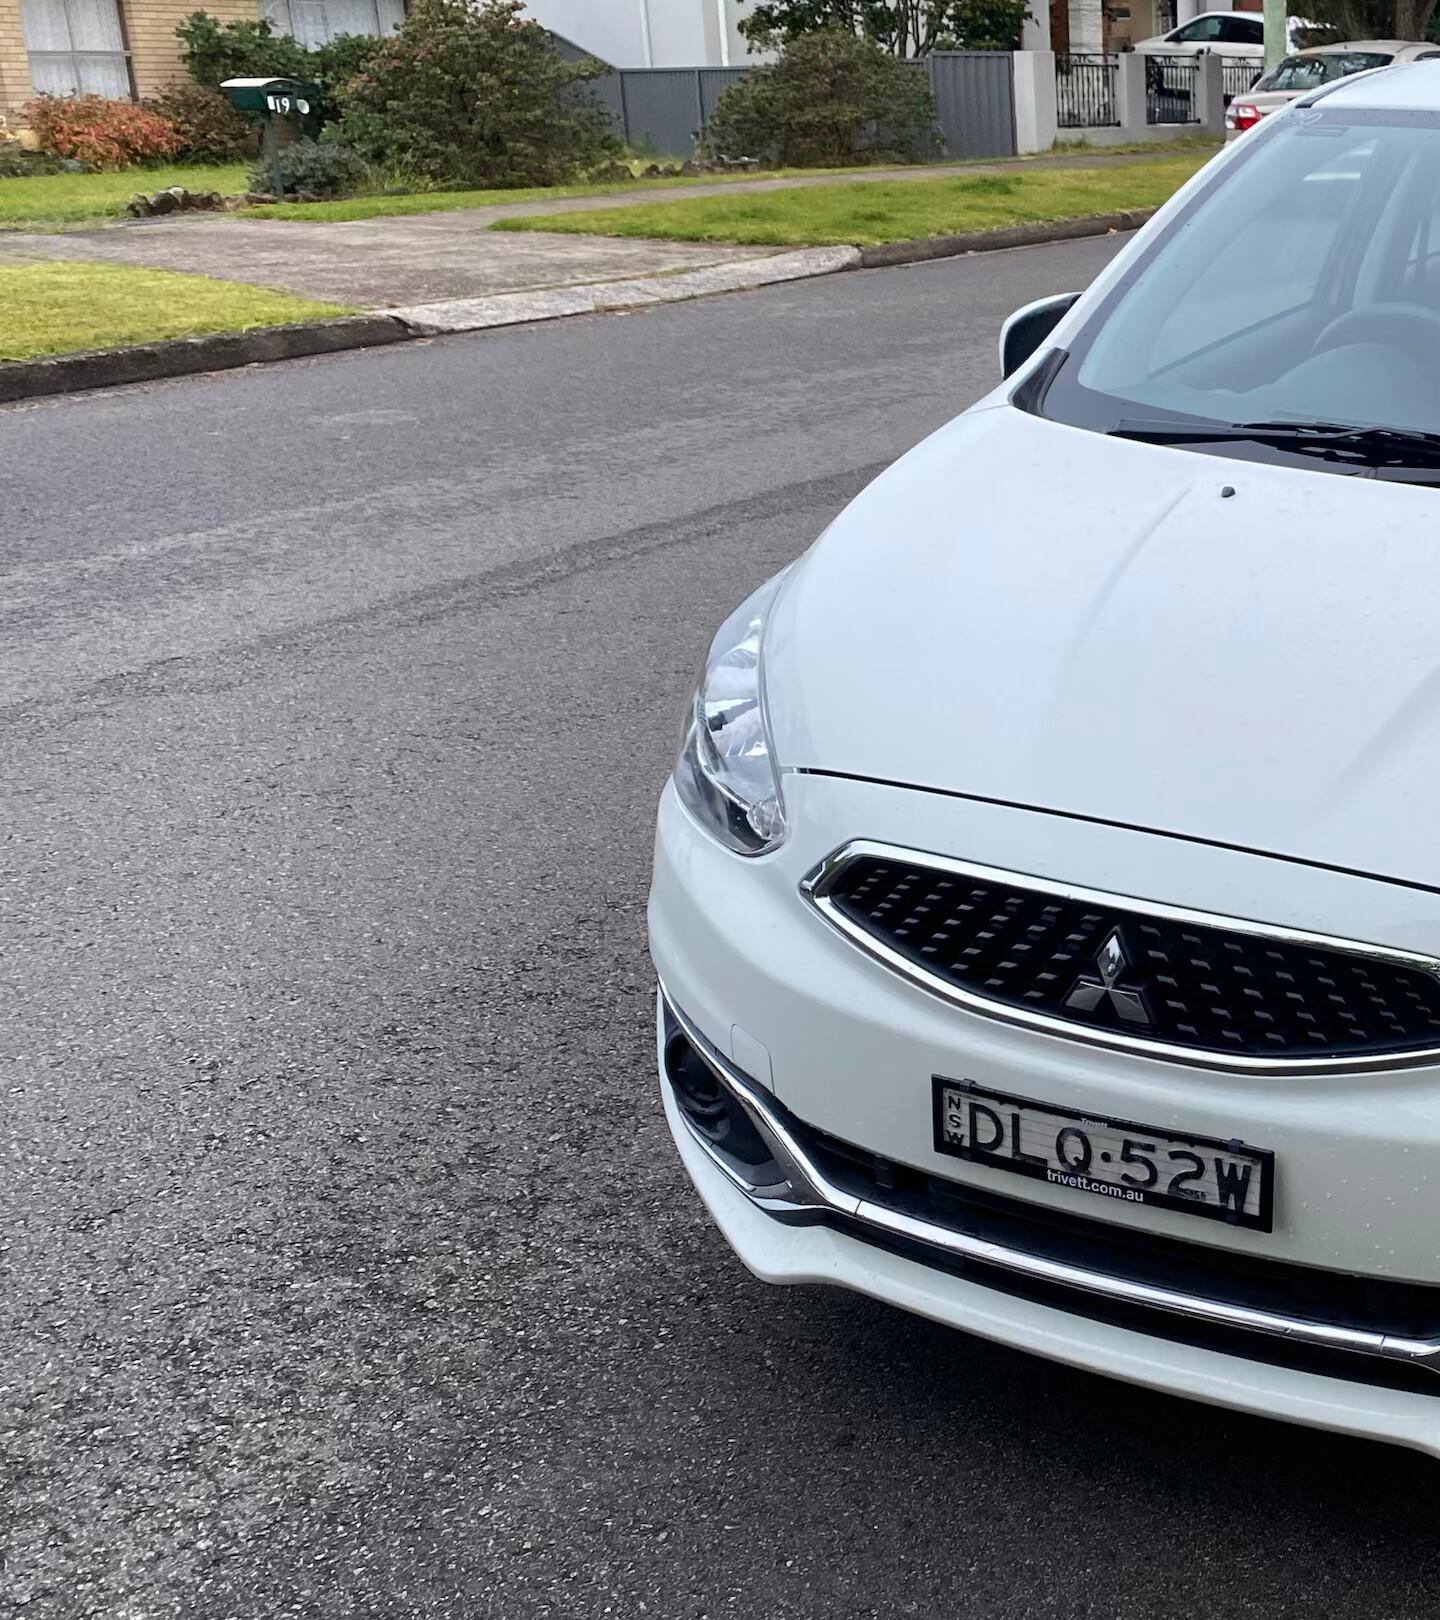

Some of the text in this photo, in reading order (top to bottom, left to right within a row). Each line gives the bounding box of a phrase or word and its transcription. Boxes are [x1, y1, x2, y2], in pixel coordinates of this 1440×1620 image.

[275, 97, 290, 113] 19
[945, 1095, 964, 1146] NSW
[1046, 1169, 1144, 1202] trivett.com.au
